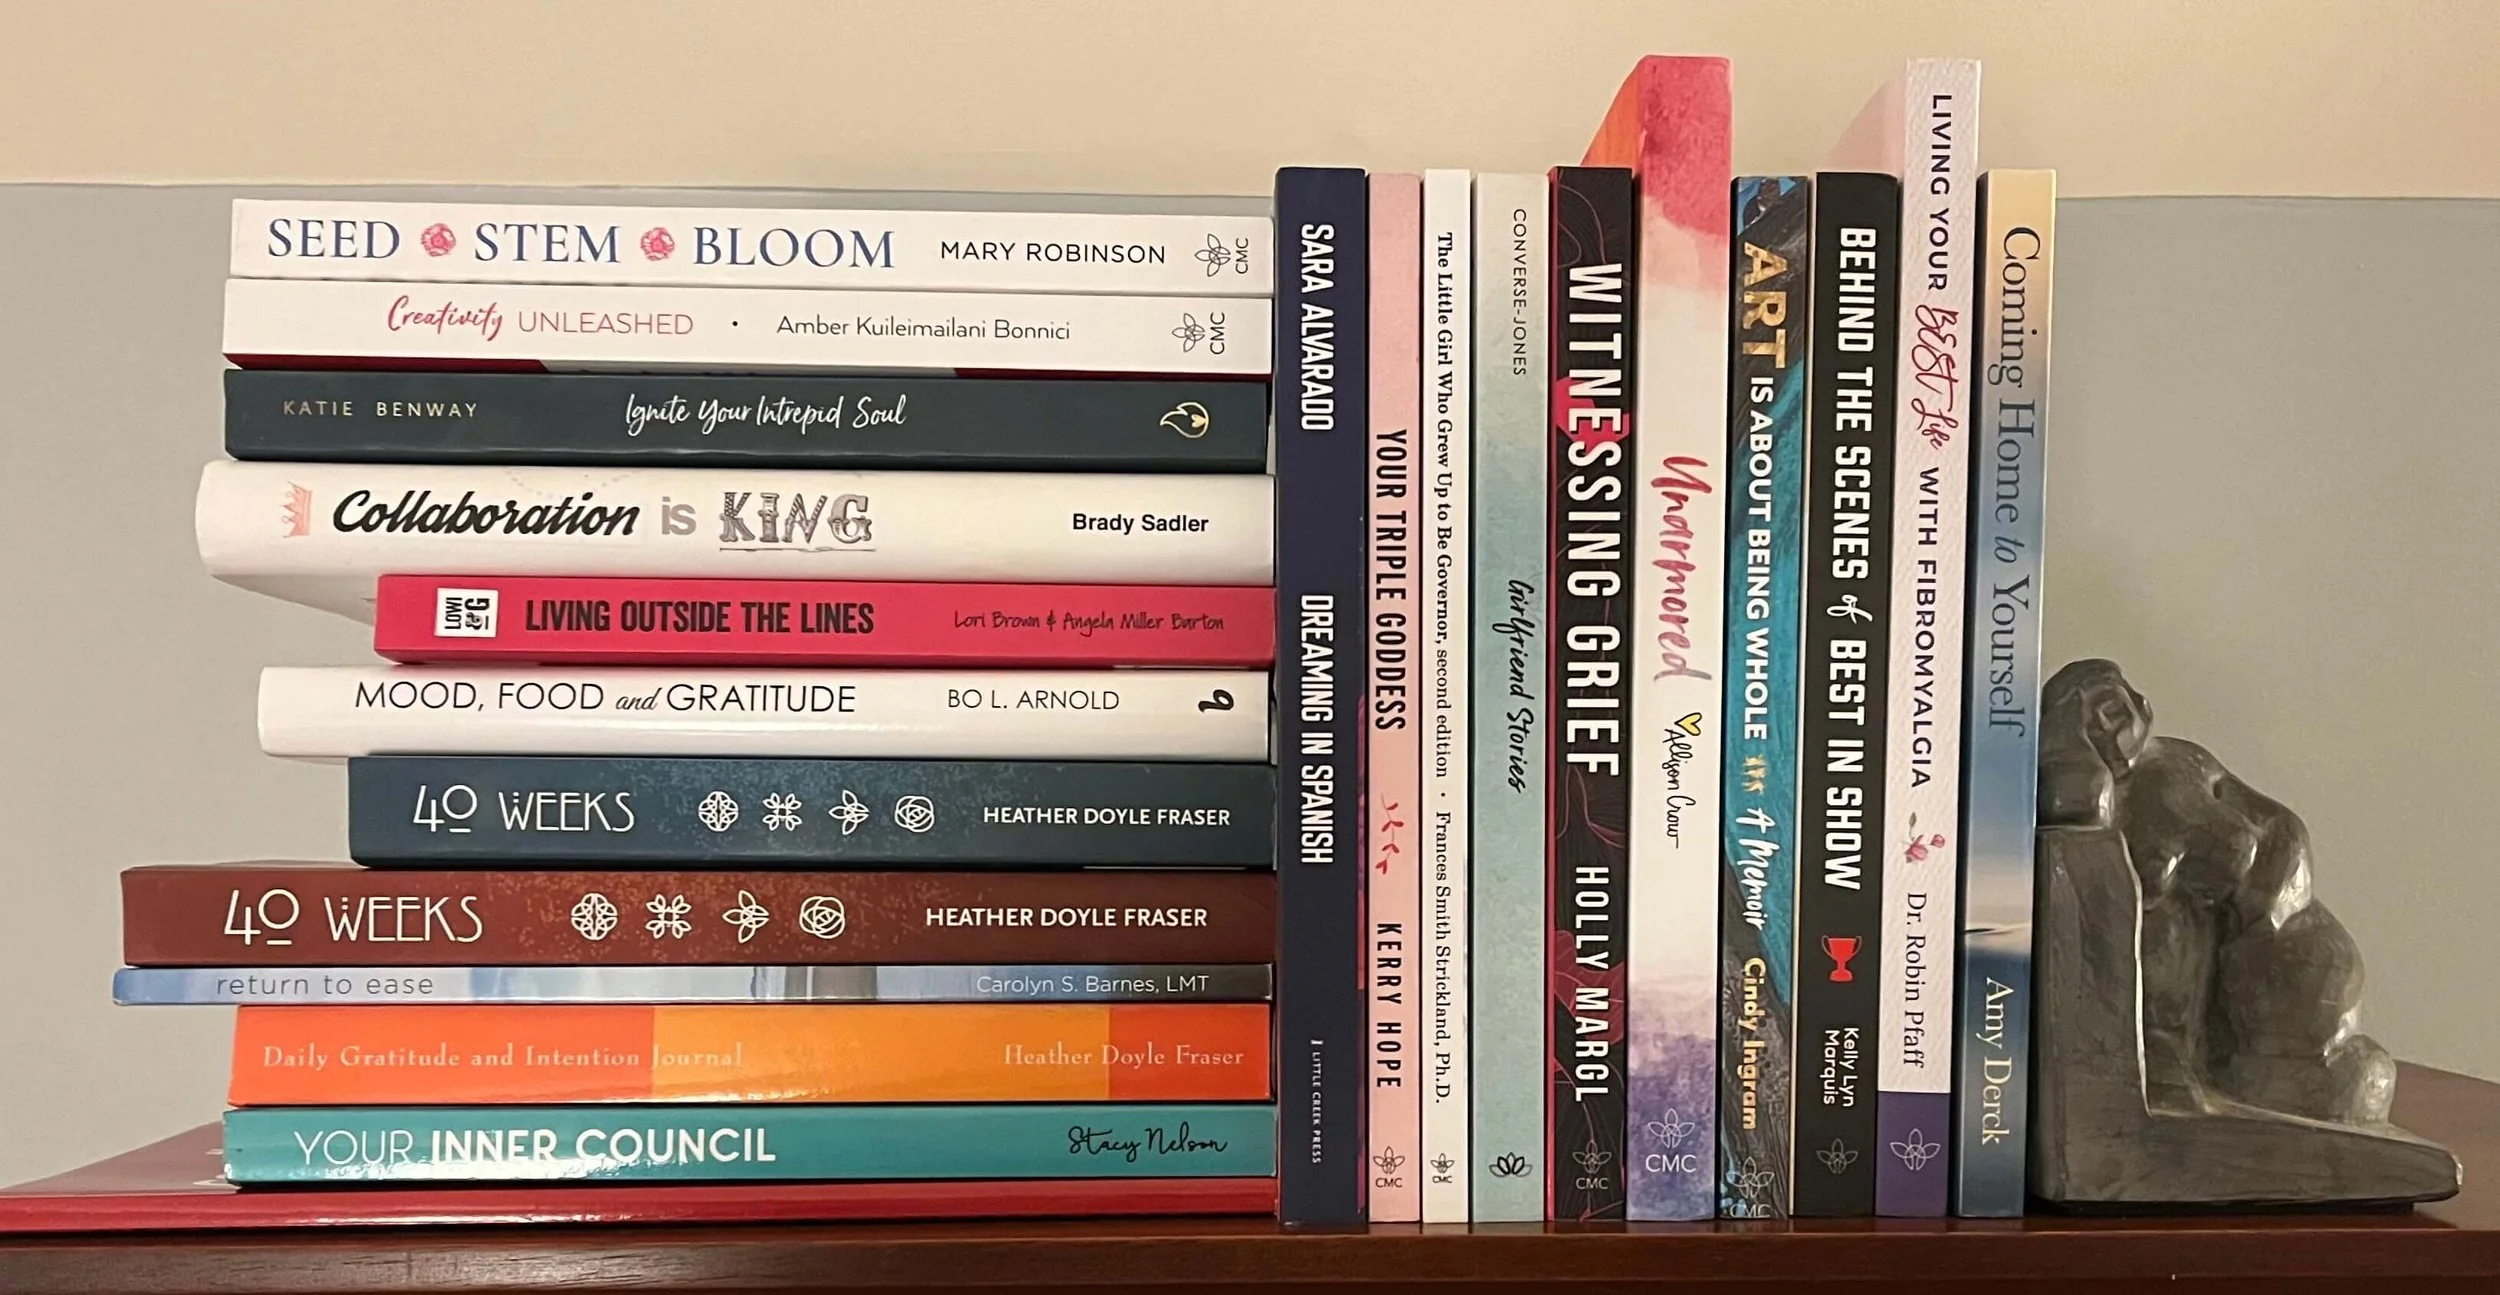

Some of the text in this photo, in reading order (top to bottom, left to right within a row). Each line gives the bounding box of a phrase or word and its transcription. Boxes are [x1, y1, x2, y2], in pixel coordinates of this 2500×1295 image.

[267, 218, 896, 269] SEED STEM BLOOM
[940, 241, 1166, 265] MARY ROBINSON
[1235, 237, 1249, 275] CMC
[1513, 208, 1527, 376] CONVERSE-JONES
[388, 295, 694, 342] Creativity UNLEASHED
[776, 315, 1070, 341] Amber Kuileimailani Bonnici
[1210, 312, 1226, 355] CMC
[1301, 223, 1335, 431] SARA ALVARADO
[283, 401, 478, 418] KATIE BENWAY
[625, 393, 907, 437] Ignite Your Intrepid Soul
[1911, 94, 1959, 788] LIVING YOUR BEST Life WITH FIBROMYALGIA
[1434, 232, 1453, 778] The Little Girl Who Grew Up to Be Governor, second edition
[1742, 241, 1788, 740] ART IS ABOUT BEING WHOLE
[1988, 226, 2041, 738] Coming Home to Yourself
[332, 490, 873, 545] Collaboration is KING
[1072, 512, 1210, 536] Brady Sadler
[1566, 263, 1623, 776] WITNESSING GRIEF
[1375, 429, 1408, 731] YOUR TRIPLE GODDESS
[1651, 456, 1713, 682] Unarmored
[1824, 227, 1877, 890] BEHIND THE SCENES of BEST IN SHOW
[444, 597, 463, 630] LOWI
[526, 600, 875, 634] LIVING OUTSIDE THE LINES
[953, 610, 1225, 638] Lori Brown & Angela Miller Barton
[355, 681, 856, 714] MOOD, FOOD and GRATITUDE
[947, 689, 1120, 710] BO L. ARNOLD
[1492, 579, 1536, 794] Girlfriend Stories
[1300, 595, 1334, 864] DREAMING IN SPANISH
[412, 784, 636, 834] 40 WEEKS
[1662, 728, 1697, 849] Allison Crow
[983, 806, 1232, 828] HEATHER DOYLE FRASER
[1735, 807, 1780, 930] A Memoir
[223, 888, 485, 946] 40 WEEKS
[926, 907, 1209, 928] HEATHER DOYLE FRASER
[1435, 812, 1451, 1104] Frances Smith Strickland, Ph.D.
[1903, 893, 1927, 1068] Dr. Robin Pfaff
[216, 975, 434, 996] return to ease
[975, 976, 1211, 996] Carolyn S. Barnes, LMT
[1376, 923, 1403, 1089] KERRY HOPE
[1575, 867, 1610, 1102] HOLLY MARGL
[263, 1044, 743, 1072] Daily Gratitude and Intention Journal
[1004, 1043, 1245, 1070] Heather Doyle Fraser
[1736, 957, 1767, 1130] Cindy Ingram
[1820, 1030, 1839, 1105] Marquis
[1839, 1027, 1859, 1107] Kelly Lyn
[1976, 977, 2015, 1144] Amy Derck
[1312, 1052, 1322, 1163] LITTLE CREEK PRESS
[294, 1127, 777, 1165] YOUR INNER COUNCIL
[1067, 1122, 1229, 1162] Stacy Nelson
[1645, 1155, 1697, 1173] CMC
[1375, 1177, 1403, 1189] CMC
[1432, 1175, 1453, 1184] CMC
[1576, 1178, 1610, 1190] CMC
[1730, 1203, 1771, 1218] CMC
